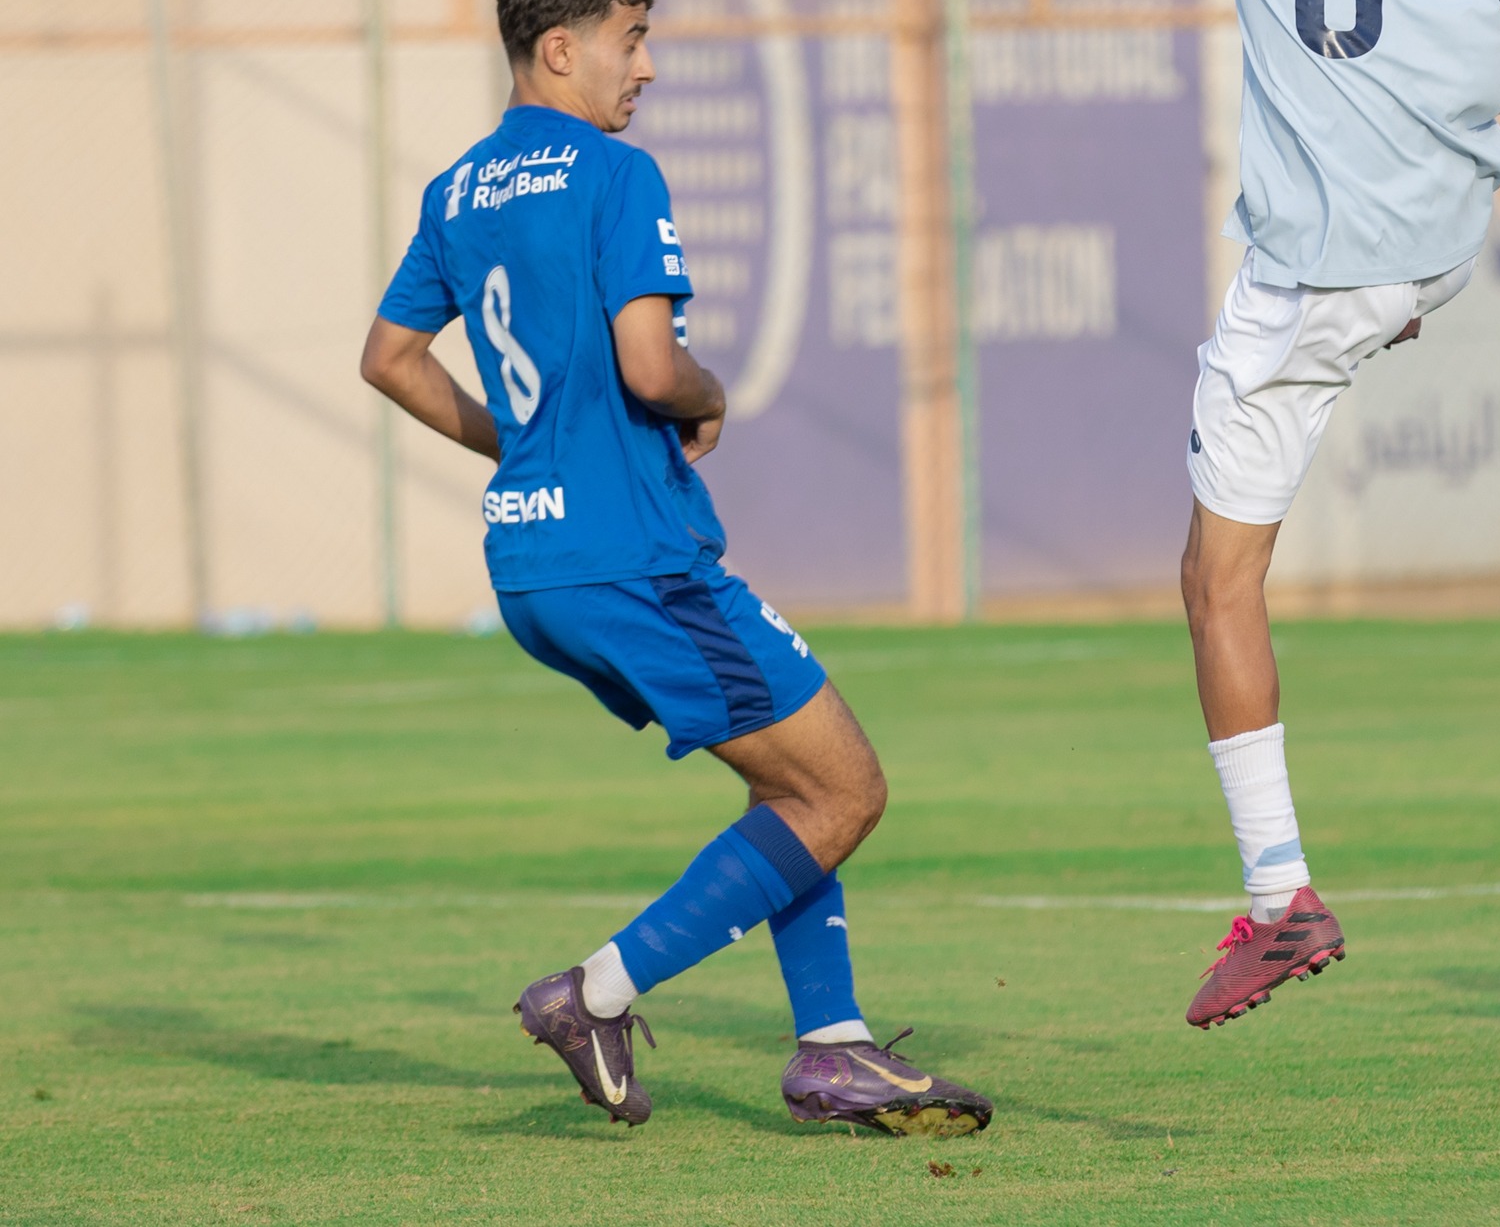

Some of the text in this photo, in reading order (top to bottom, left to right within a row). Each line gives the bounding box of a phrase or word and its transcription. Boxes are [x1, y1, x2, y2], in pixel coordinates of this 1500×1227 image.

[521, 144, 579, 167] بنك
[515, 168, 570, 197] Bank
[481, 264, 541, 426] 8
